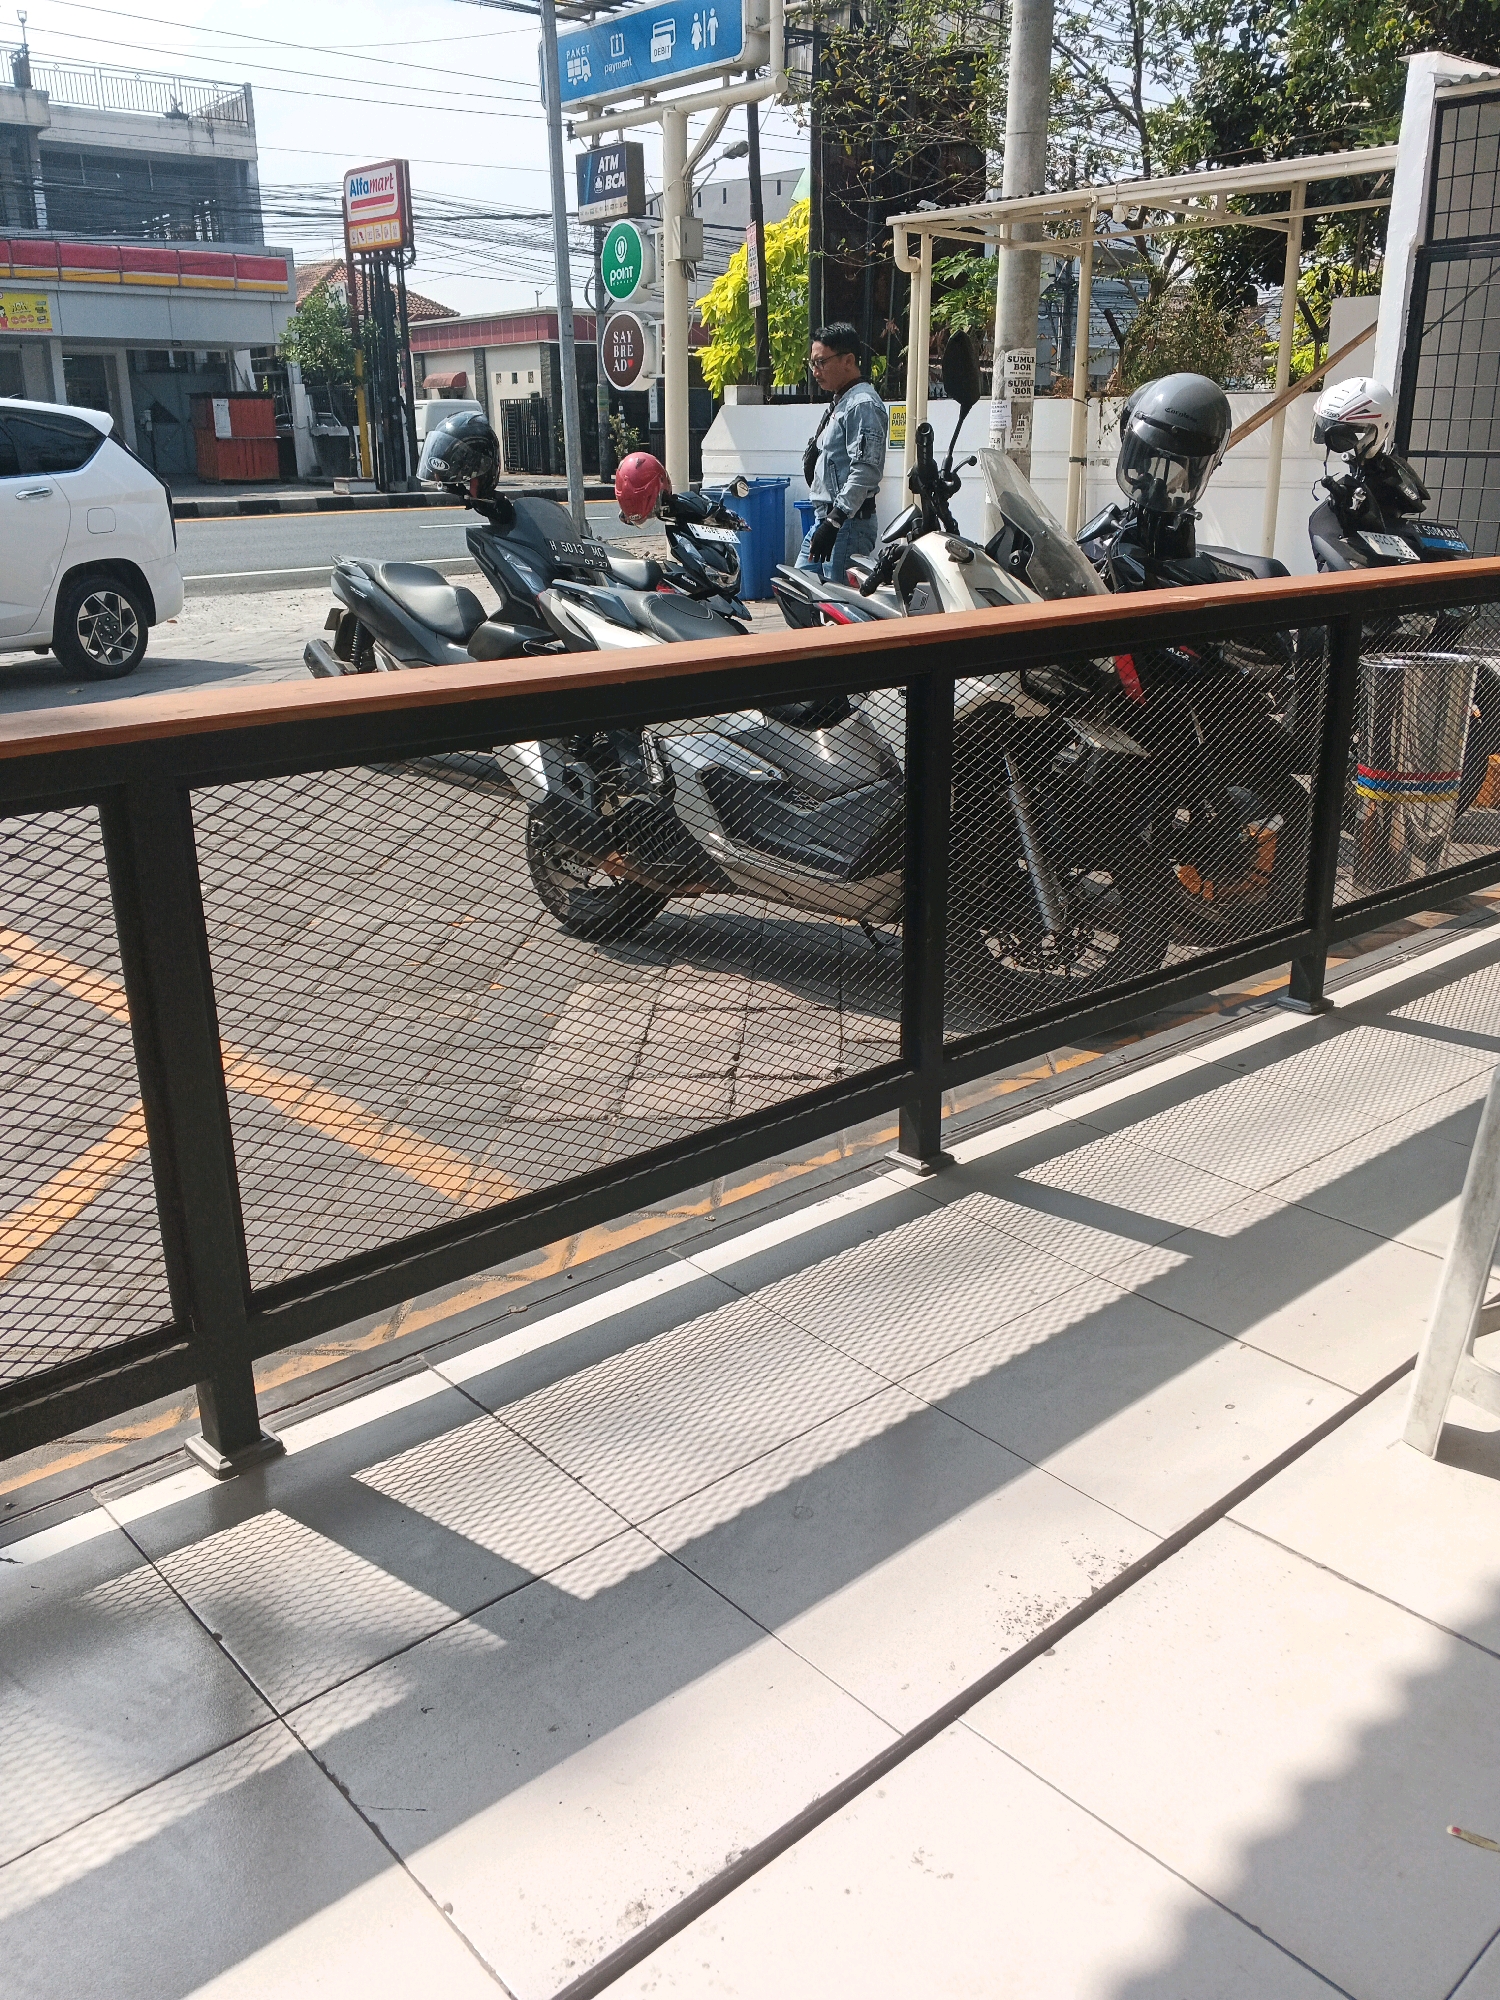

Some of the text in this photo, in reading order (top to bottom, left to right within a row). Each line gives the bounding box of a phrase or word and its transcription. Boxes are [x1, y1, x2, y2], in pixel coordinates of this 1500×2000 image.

[566, 45, 590, 60] PAKET
[653, 45, 670, 57] DEBIT
[604, 56, 633, 76] payment
[598, 153, 619, 174] ATM
[349, 172, 394, 198] Alfamart
[604, 171, 626, 191] BCA
[613, 330, 633, 344] SAY
[613, 344, 634, 358] BRE
[613, 359, 628, 372] AD
[1013, 363, 1031, 371] BOR
[1014, 387, 1031, 395] BOR
[549, 540, 557, 551] H
[560, 541, 585, 555] 5013
